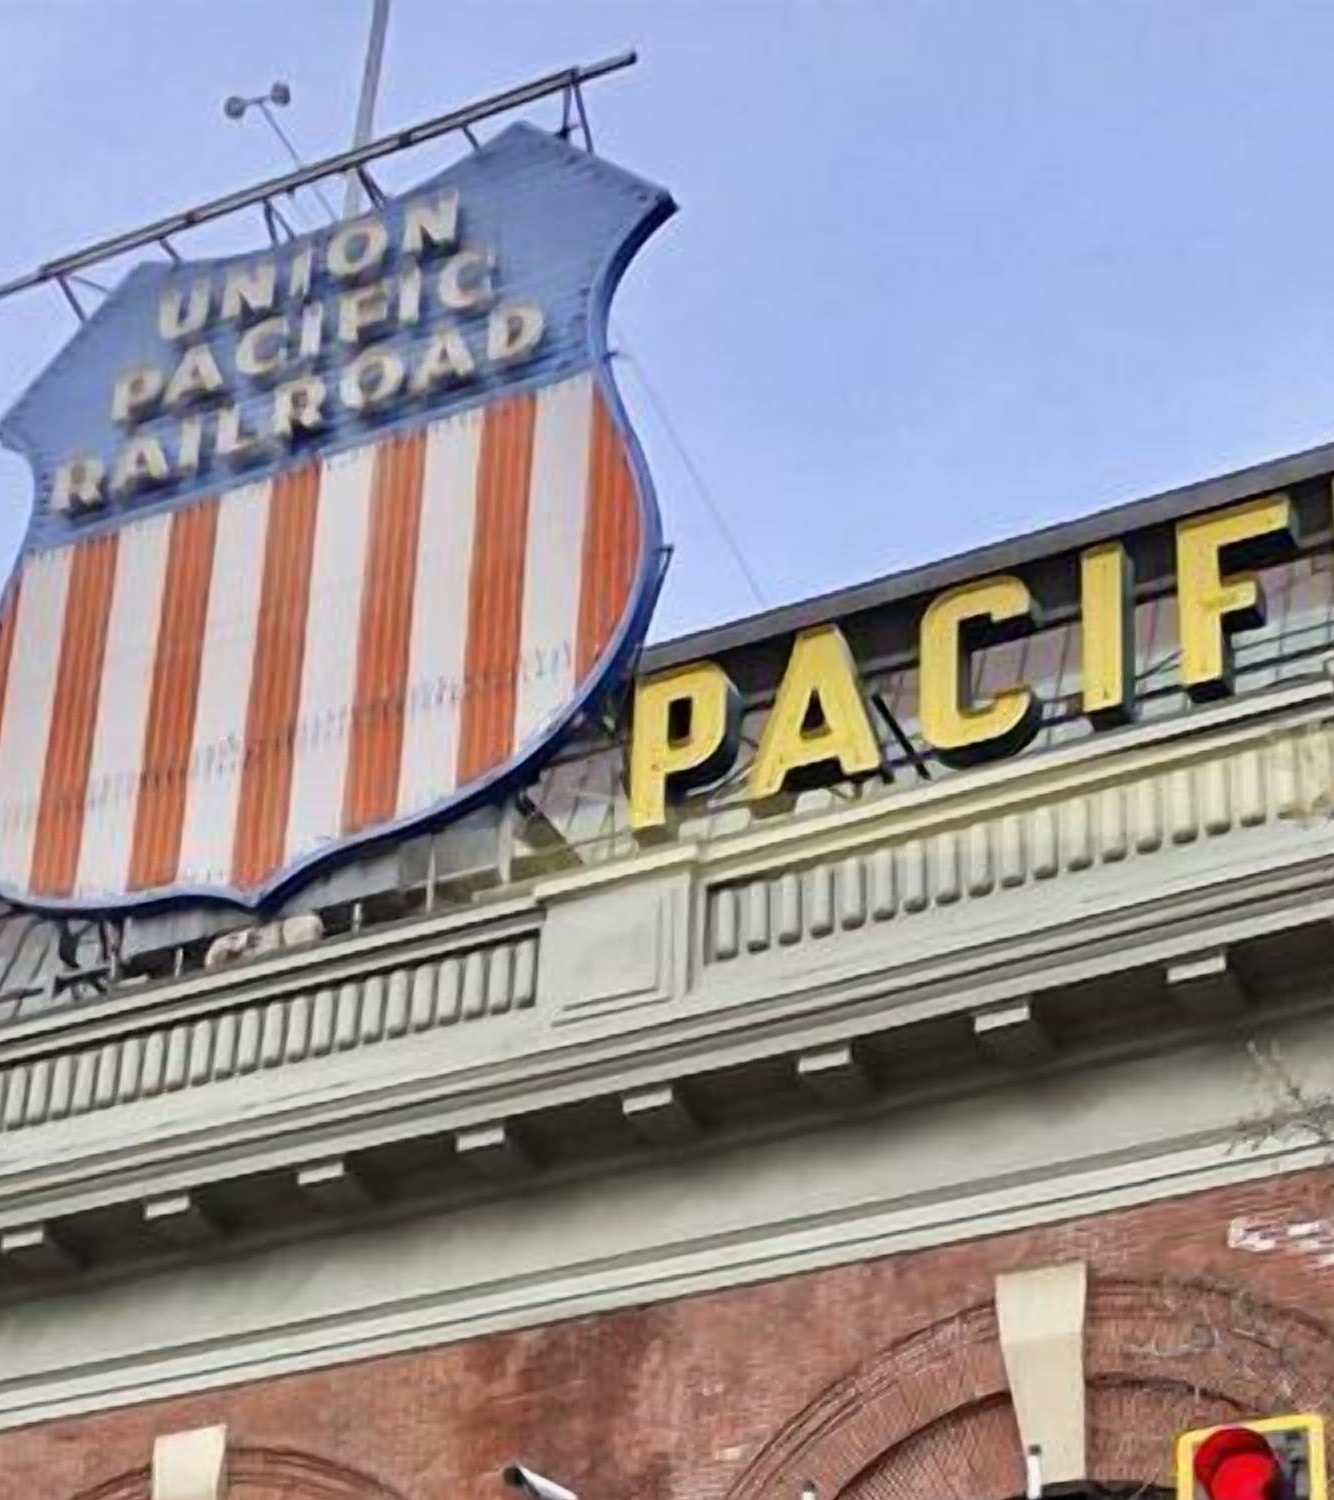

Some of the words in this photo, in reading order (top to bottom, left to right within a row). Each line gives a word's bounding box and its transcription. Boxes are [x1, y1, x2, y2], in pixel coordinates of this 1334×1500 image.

[110, 246, 499, 424] PACIFIC
[158, 191, 460, 342] UNION
[49, 305, 545, 513] RAILROAD
